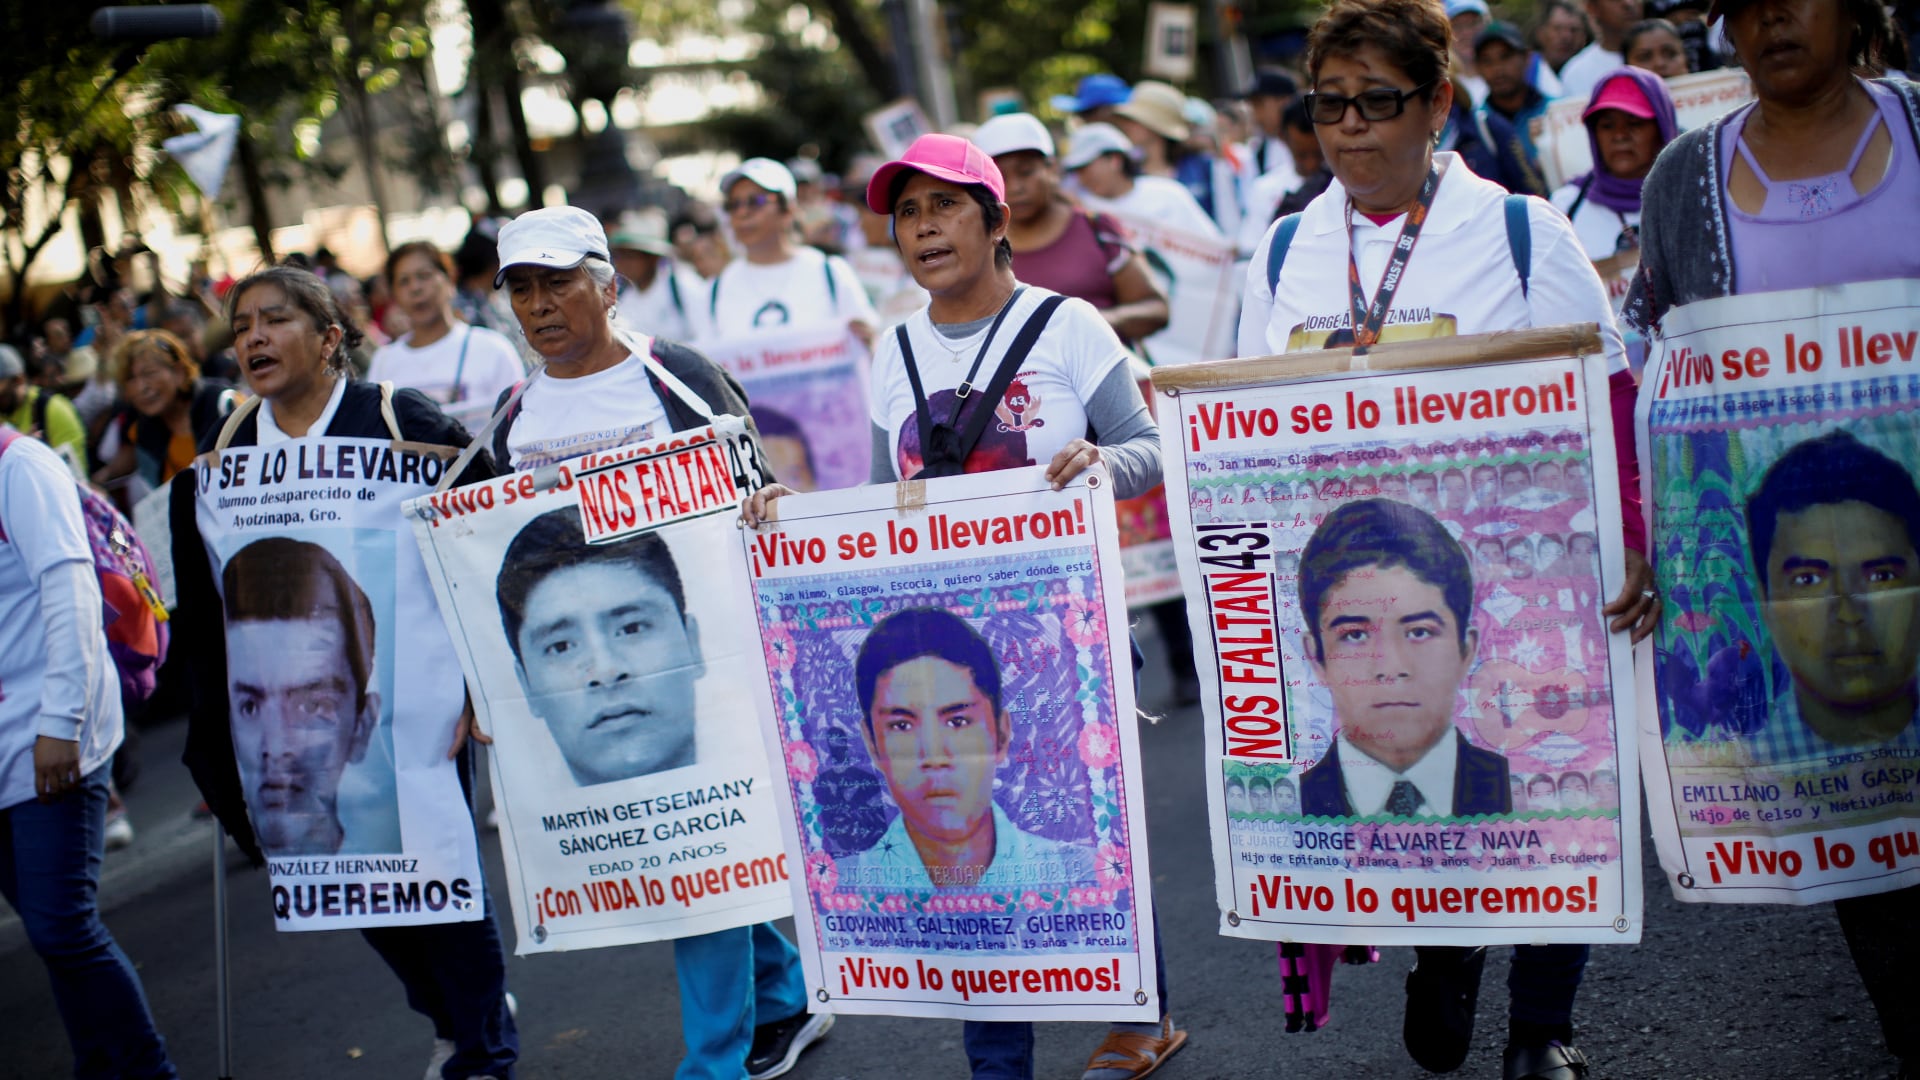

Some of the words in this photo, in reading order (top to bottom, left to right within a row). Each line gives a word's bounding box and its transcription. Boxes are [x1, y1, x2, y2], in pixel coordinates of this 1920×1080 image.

[1305, 314, 1340, 330] JORGE
[1398, 307, 1431, 323] NAVA
[1659, 347, 1714, 399] ¡Vivo
[1721, 346, 1770, 381] se
[1785, 333, 1823, 374] lo
[1838, 326, 1919, 368] llev
[1010, 395, 1026, 407] 43
[1188, 401, 1279, 452] ¡Vivo
[1291, 402, 1333, 434] se
[1346, 391, 1381, 430] lo
[1394, 371, 1578, 426] llevaron!
[219, 454, 249, 489] SE
[260, 449, 286, 485] LO
[298, 444, 450, 487] LLEVARO
[1193, 461, 1212, 473] Yo,
[1218, 460, 1239, 470] Jan
[1244, 457, 1282, 469] Nimmo,
[1288, 453, 1339, 466] Glasgow,
[1347, 449, 1403, 461] Escocia,
[1463, 439, 1498, 451] saber
[260, 487, 351, 505] desaparecido
[357, 488, 376, 501] de
[503, 474, 536, 504] se
[578, 469, 636, 537] NOS
[635, 444, 737, 522] FALTAN
[232, 510, 305, 529] Ayotzinapa,
[309, 508, 341, 522] Gro.
[750, 532, 826, 578] ¡Vivo
[837, 530, 877, 560] se
[887, 519, 918, 555] lo
[928, 498, 1087, 550] llevaron!
[1196, 522, 1271, 571] 43!
[759, 593, 776, 605] Yo,
[778, 591, 795, 602] Jan
[798, 588, 832, 601] Nimmo,
[837, 583, 885, 598] Glasgow,
[890, 577, 938, 592] Escocia,
[944, 572, 982, 588] quiero
[987, 568, 1020, 582] saber
[1026, 562, 1060, 577] dónde
[1066, 560, 1093, 573] está
[1209, 572, 1277, 684] FALTAN
[1224, 695, 1283, 759] NOS
[541, 806, 610, 832] MARTÍN
[613, 777, 755, 822] GETSEMANY
[1682, 784, 1780, 802] EMILIANO
[1793, 775, 1849, 799] ALEN
[1690, 809, 1724, 823] Hijo
[1733, 808, 1750, 820] de
[1757, 808, 1802, 822] Celso
[1811, 804, 1821, 819] y
[1830, 791, 1914, 813] Natividad
[559, 828, 649, 856] SÁNCHEZ
[653, 807, 747, 841] GARCÍA
[1294, 830, 1356, 851] JORGE
[1370, 827, 1467, 851] ÁLVAREZ
[1482, 829, 1542, 850] NAVA
[335, 859, 419, 875] HERNANDEZ
[588, 860, 633, 876] EDAD
[640, 855, 661, 869] 20
[667, 841, 727, 864] AÑOS
[1241, 852, 1270, 866] Hijo
[1273, 853, 1285, 865] de
[1288, 854, 1341, 868] Epifanio
[1344, 858, 1351, 869] y
[1358, 855, 1399, 867] Blanca
[1420, 855, 1434, 867] 19
[1441, 854, 1470, 867] años
[1490, 854, 1520, 867] Juan
[1527, 854, 1541, 865] R.
[1550, 852, 1607, 864] Escudero
[1706, 841, 1802, 884] ¡Vivo
[1813, 836, 1856, 871] lo
[1868, 831, 1919, 870] qu
[272, 878, 473, 920] QUEREMOS
[535, 885, 582, 925] ¡Con
[582, 877, 640, 913] VIDA
[640, 875, 665, 907] lo
[1250, 874, 1334, 917] ¡Vivo
[1345, 878, 1378, 913] lo
[1391, 875, 1598, 922] queremos!
[825, 915, 906, 934] GIOVANNI
[917, 916, 1014, 935] GALINDREZ
[1027, 912, 1126, 933] GUERRERO
[828, 936, 851, 948] Hijo
[854, 937, 866, 947] de
[934, 941, 941, 951] y
[976, 939, 1005, 951] Elena
[1023, 939, 1036, 949] 19
[1042, 937, 1067, 948] años
[1085, 936, 1127, 947] Arcelia
[839, 957, 909, 995] ¡Vivo
[916, 959, 944, 991] lo
[951, 958, 1121, 1002] queremos!
